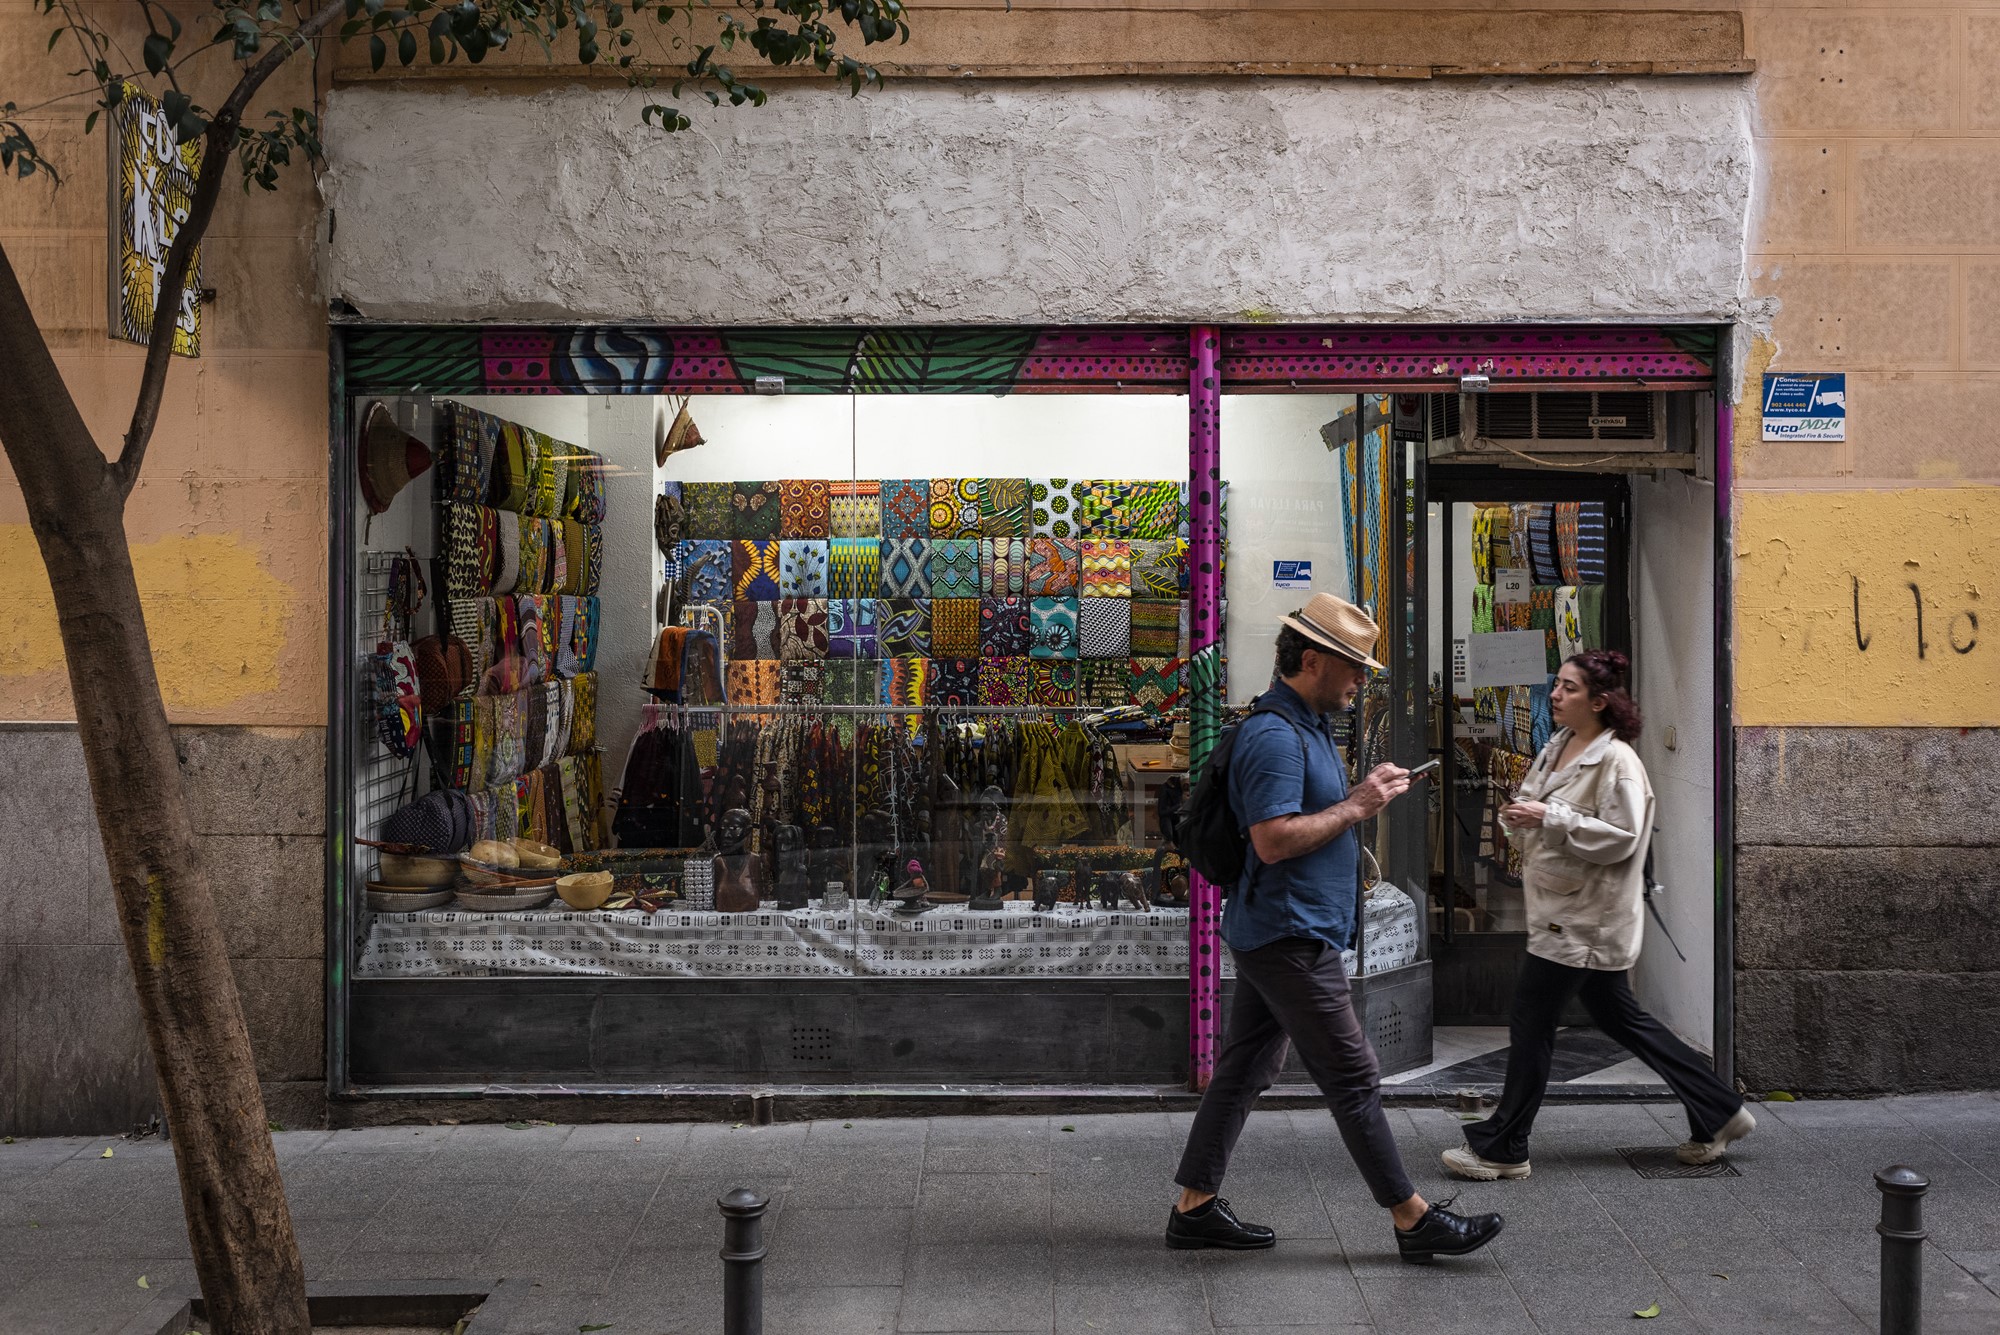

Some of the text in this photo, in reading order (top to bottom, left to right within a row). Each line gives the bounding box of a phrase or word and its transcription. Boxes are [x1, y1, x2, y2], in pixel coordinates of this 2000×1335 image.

[1764, 423, 1798, 435] tyco
[1505, 582, 1520, 590] L20
[1467, 726, 1486, 734] Tirar
